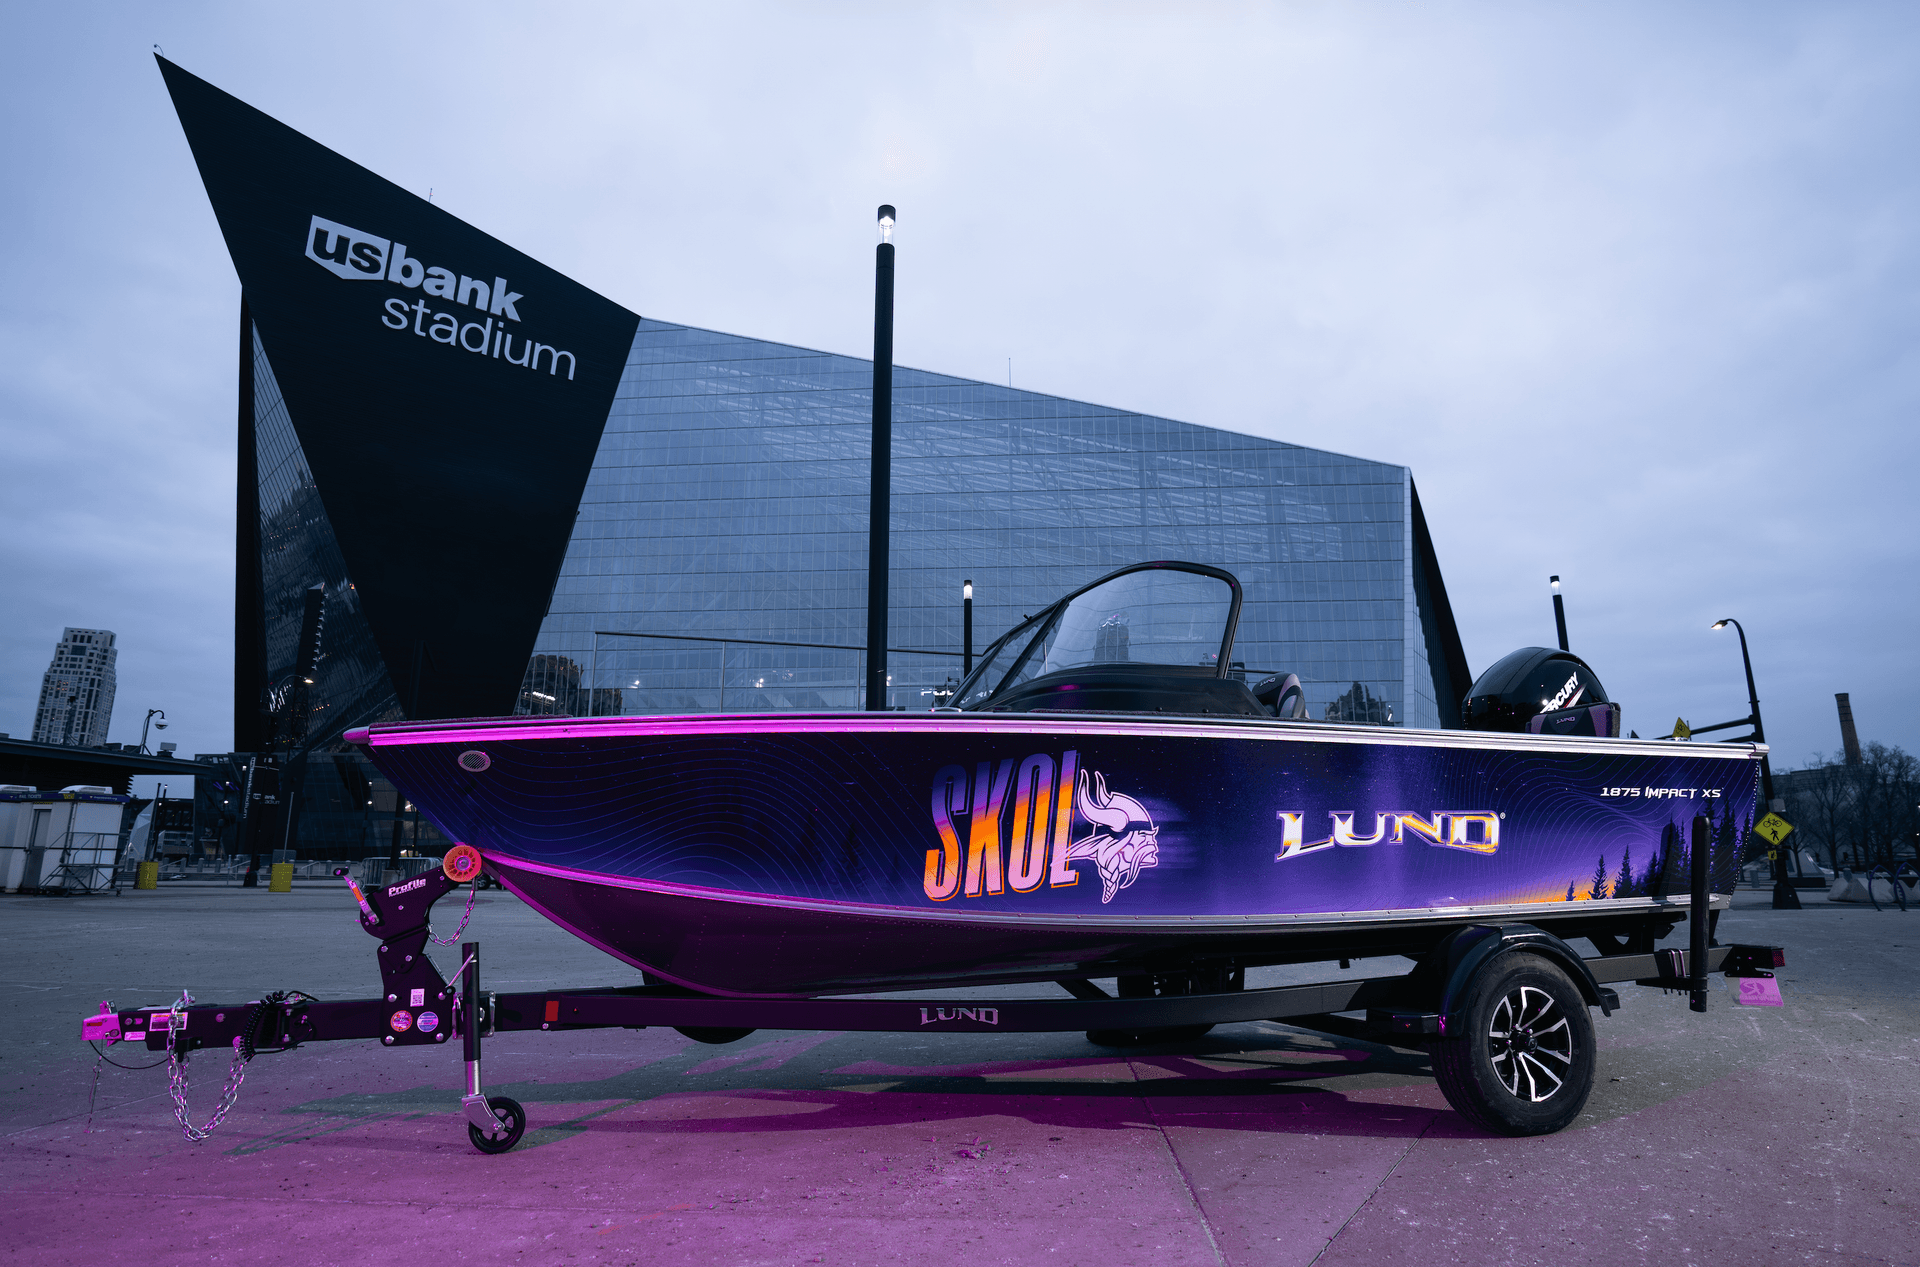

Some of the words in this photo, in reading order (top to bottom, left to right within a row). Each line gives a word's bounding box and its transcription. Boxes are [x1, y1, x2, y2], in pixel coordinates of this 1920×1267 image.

[381, 298, 577, 381] stadium
[1600, 787, 1641, 797] 1875
[1645, 786, 1698, 800] IMPACT
[1702, 788, 1722, 798] XS
[923, 750, 1081, 902] SKOL
[1275, 811, 1500, 863] LUND
[388, 878, 427, 895] Profile
[919, 1007, 999, 1026] LUND
